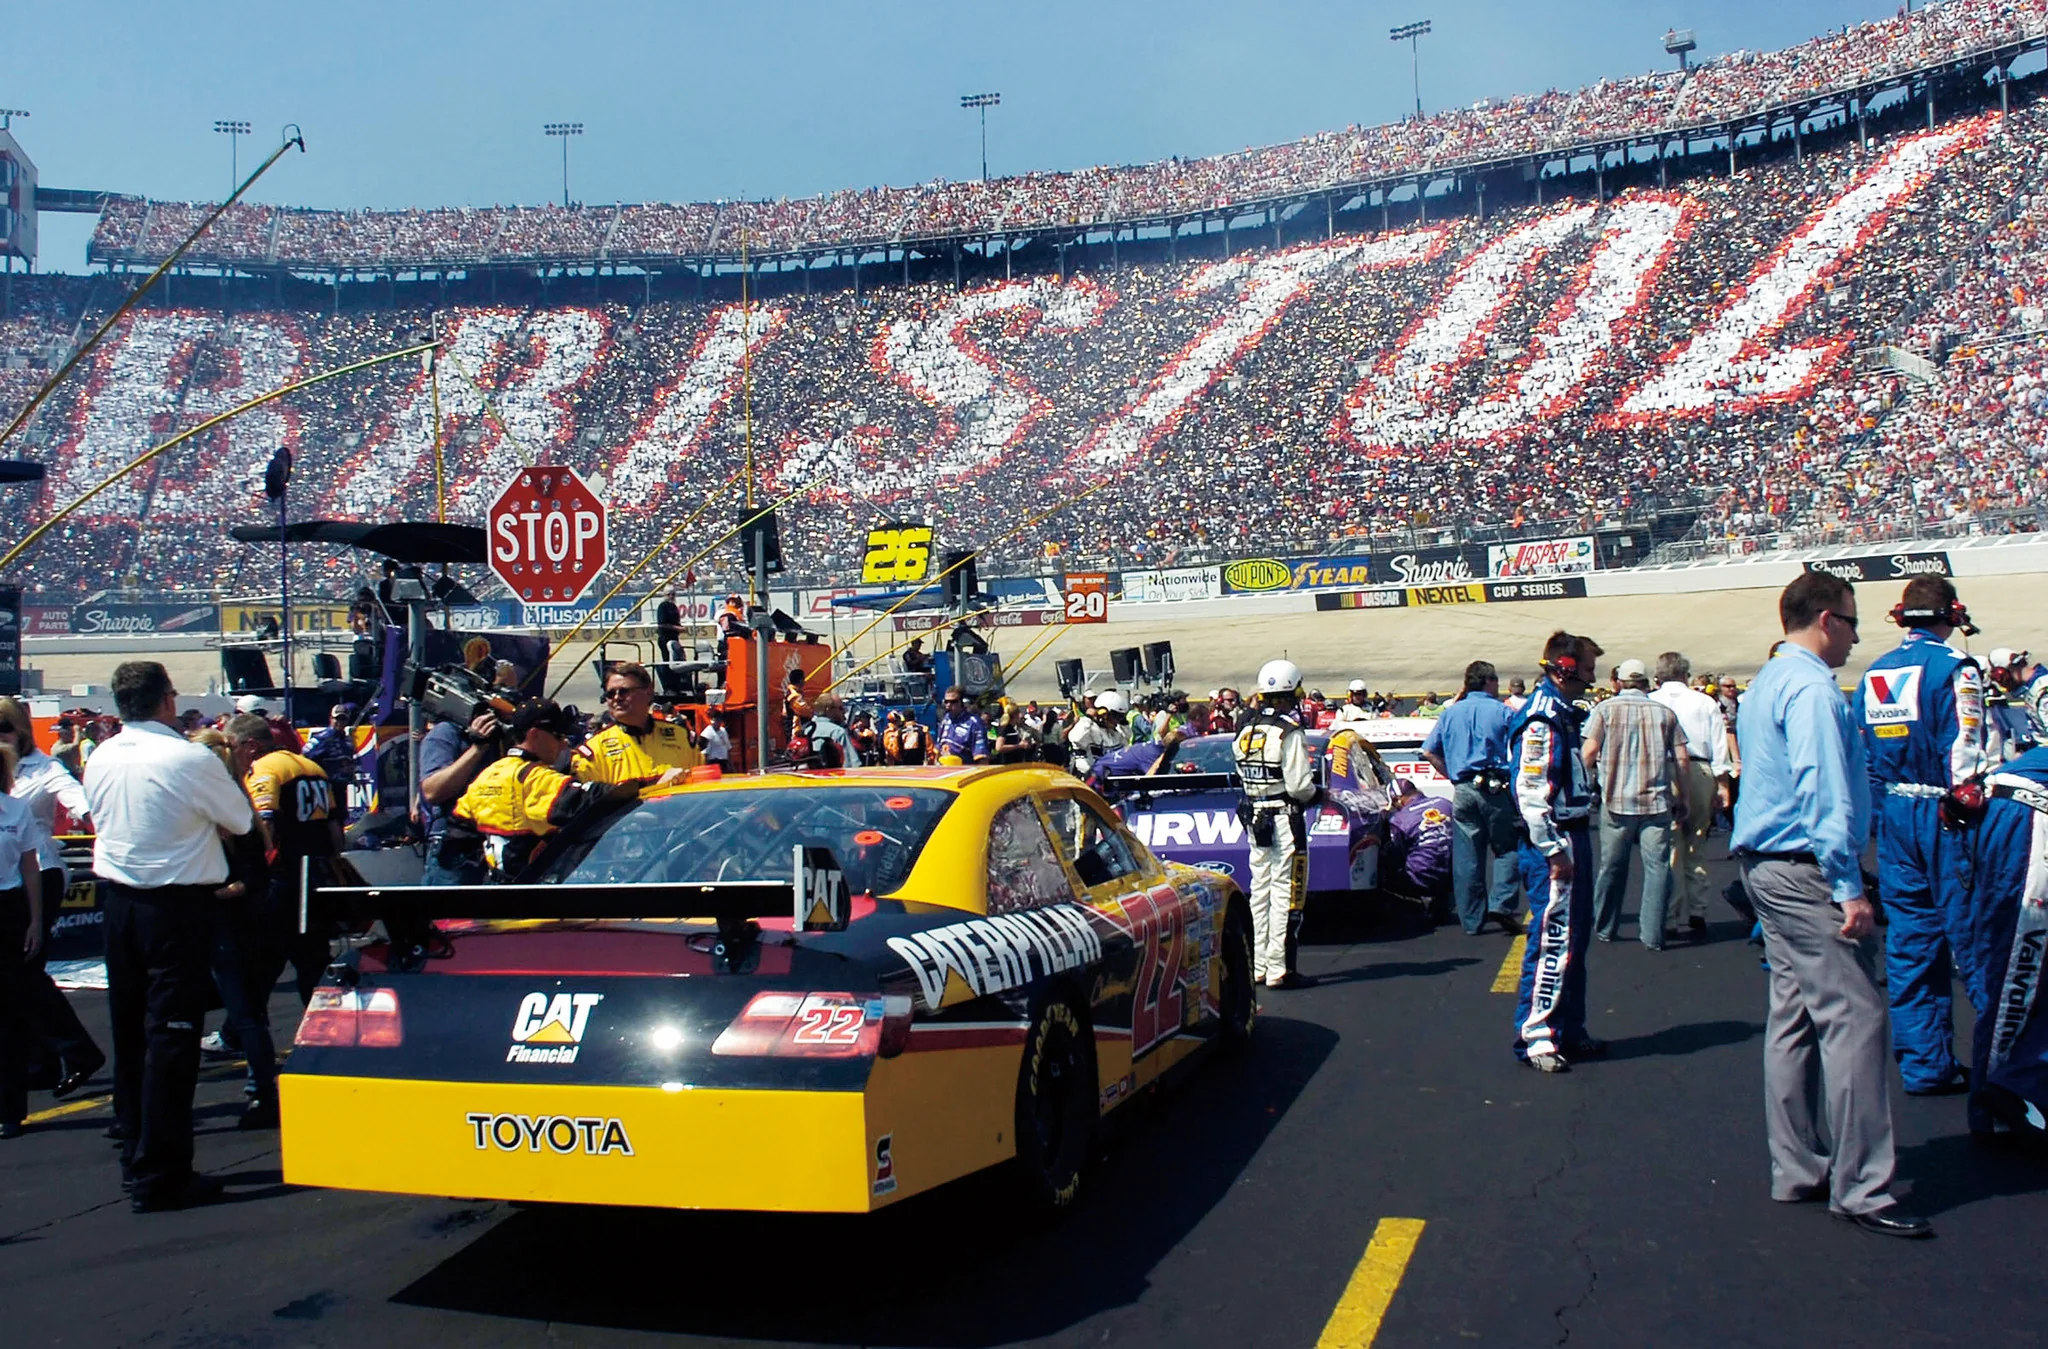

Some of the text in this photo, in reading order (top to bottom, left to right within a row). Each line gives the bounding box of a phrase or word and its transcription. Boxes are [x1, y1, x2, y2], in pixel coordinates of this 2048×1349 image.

[496, 511, 599, 563] STOP
[862, 528, 932, 583] 26
[1513, 543, 1569, 569] JASPER
[1890, 555, 1947, 578] Sharpie
[1148, 572, 1217, 586] Nationwide
[1309, 566, 1369, 585] YEAR
[1384, 554, 1473, 584] Sharpie
[1811, 561, 1864, 580] Sharpie
[1068, 592, 1105, 617] 20
[1361, 583, 1564, 607] NASCAR NEXTEL CUP SERIES
[41, 611, 68, 620] AUTO
[79, 610, 155, 633] Sharpie
[678, 603, 708, 618] OOD
[39, 620, 70, 630] PARTS
[1867, 708, 1912, 720] Valvoline
[1331, 744, 1349, 778] IRWIN
[296, 779, 330, 822] CAT
[1135, 811, 1245, 846] IRW
[1318, 814, 1344, 831] 26
[802, 866, 842, 923] CAT
[56, 911, 105, 929] ACING
[886, 903, 1102, 1010] CATERPILLAR
[1537, 909, 1566, 1010] Valvoline
[1117, 884, 1184, 1058] 22
[512, 992, 599, 1042] CAT
[794, 1005, 864, 1045] 22
[506, 1045, 579, 1063] Financial
[466, 1111, 636, 1157] TOYOTA
